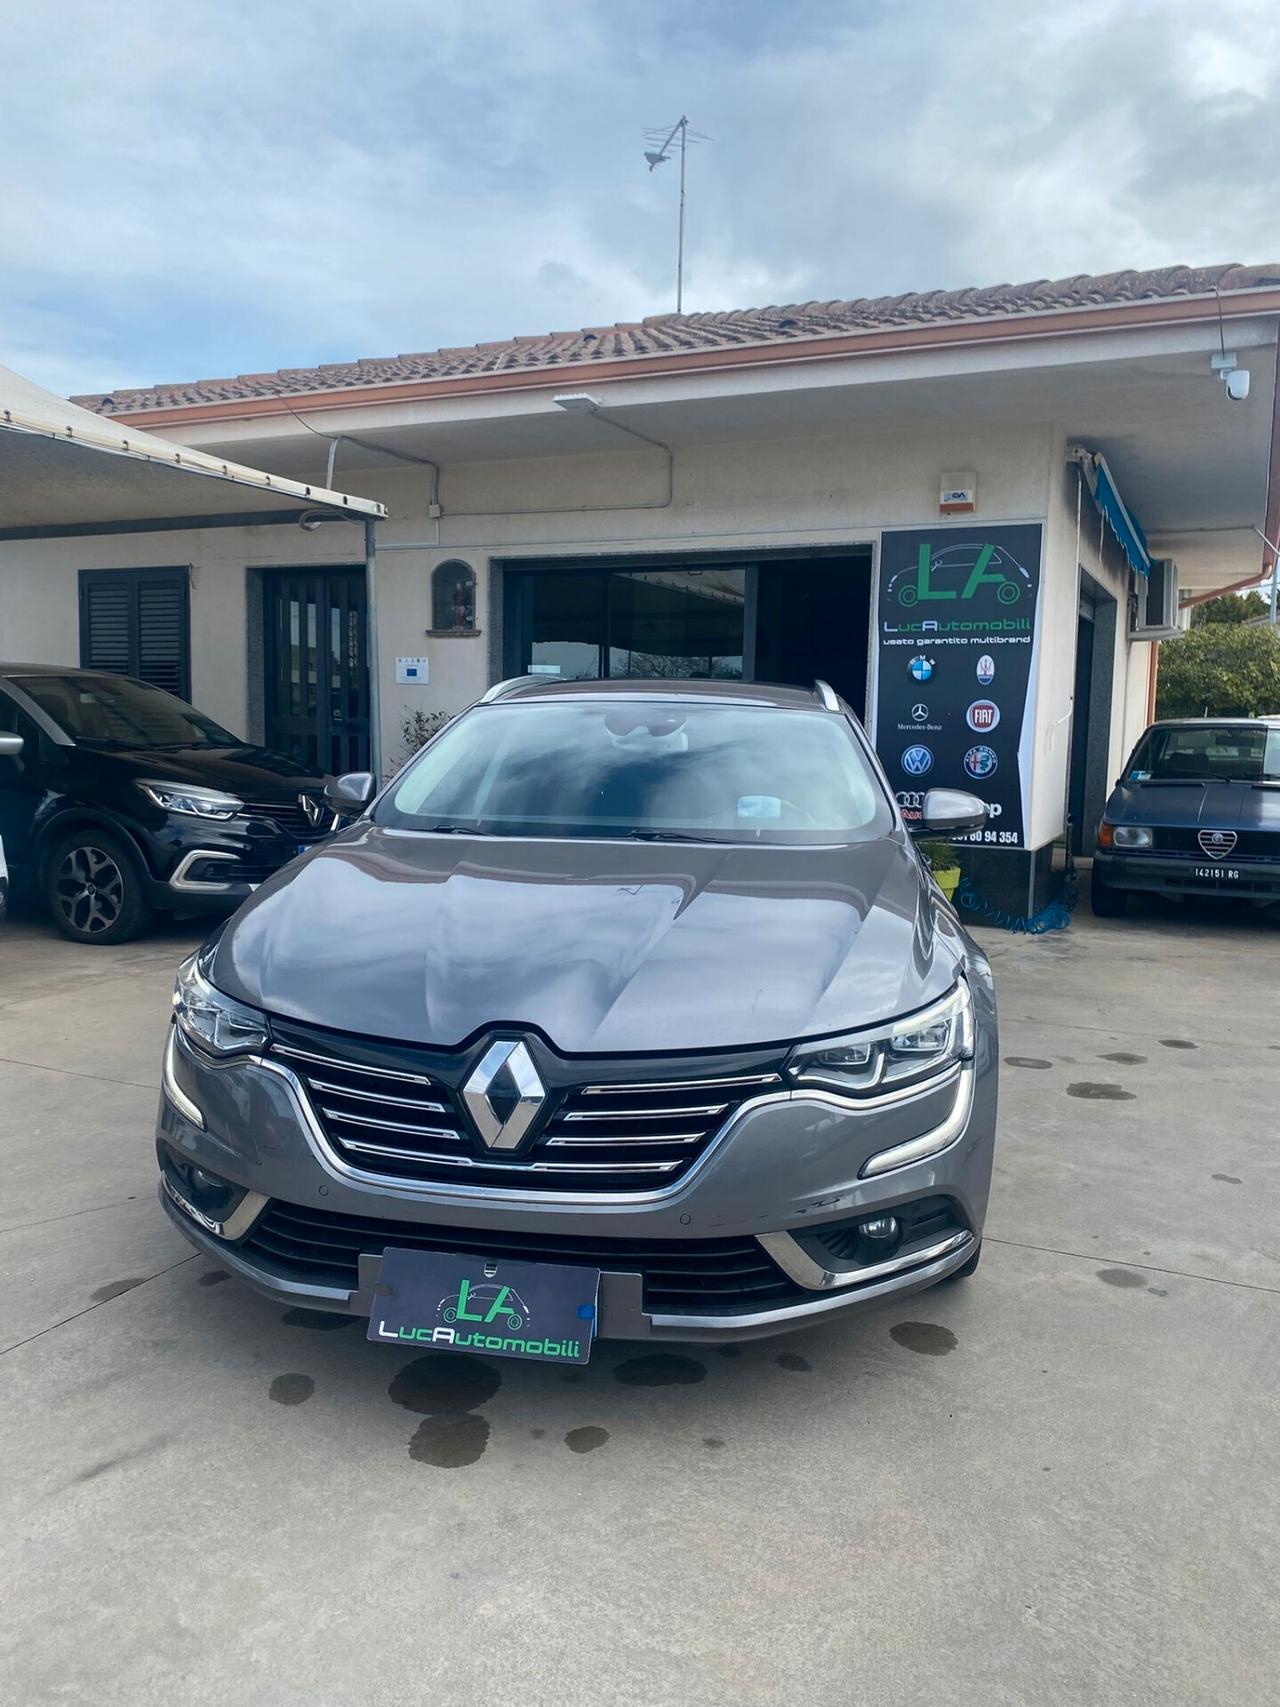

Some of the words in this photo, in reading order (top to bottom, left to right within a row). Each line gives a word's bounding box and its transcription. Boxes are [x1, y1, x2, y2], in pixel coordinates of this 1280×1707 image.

[883, 617, 1031, 632] LucAutomobili
[883, 637, 915, 646] usato
[916, 636, 968, 647] garantito
[970, 635, 1031, 644] multibrand
[974, 708, 993, 724] FIAT
[897, 723, 942, 731] Mercedes-Benz
[984, 831, 997, 843] 94
[999, 831, 1018, 844] 354
[1228, 869, 1239, 879] RG
[378, 1320, 580, 1358] LucAutomobili
